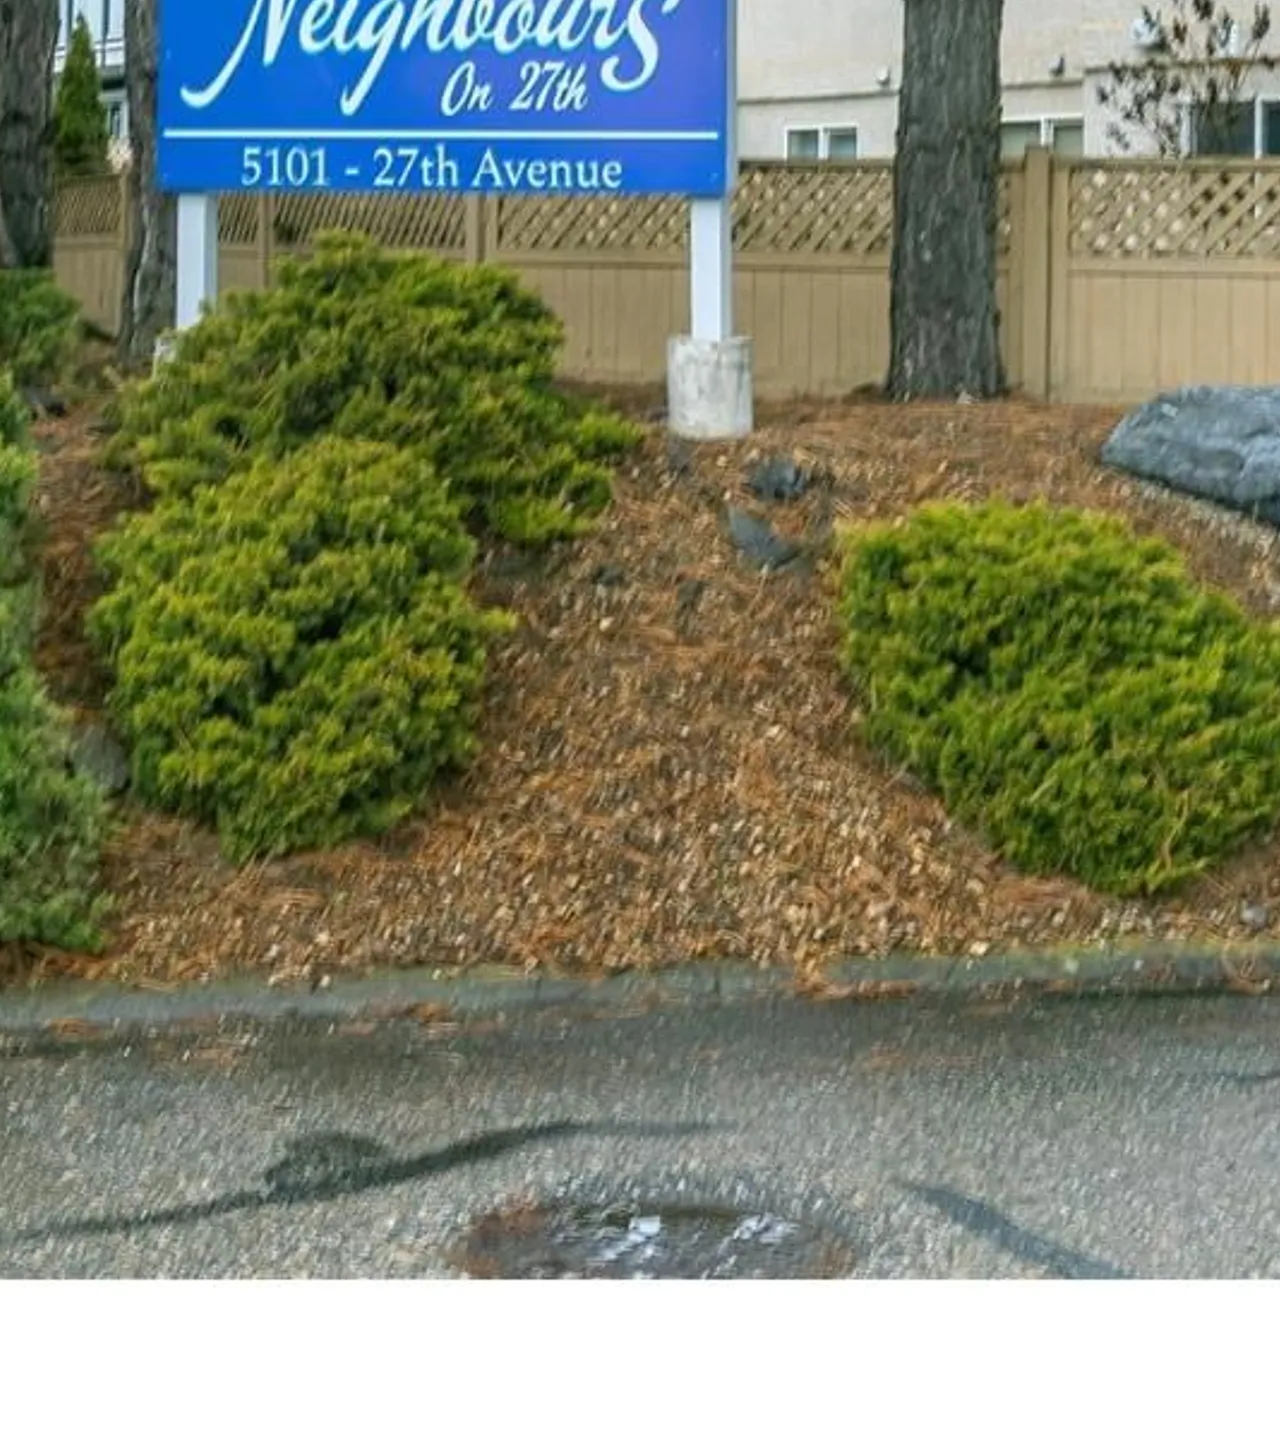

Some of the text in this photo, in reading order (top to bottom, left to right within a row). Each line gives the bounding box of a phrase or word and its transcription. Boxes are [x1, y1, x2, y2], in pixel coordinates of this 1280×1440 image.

[440, 61, 589, 117] On 27th
[241, 146, 327, 186] 5101
[372, 145, 459, 188] 27th
[470, 148, 623, 190] Avenue
